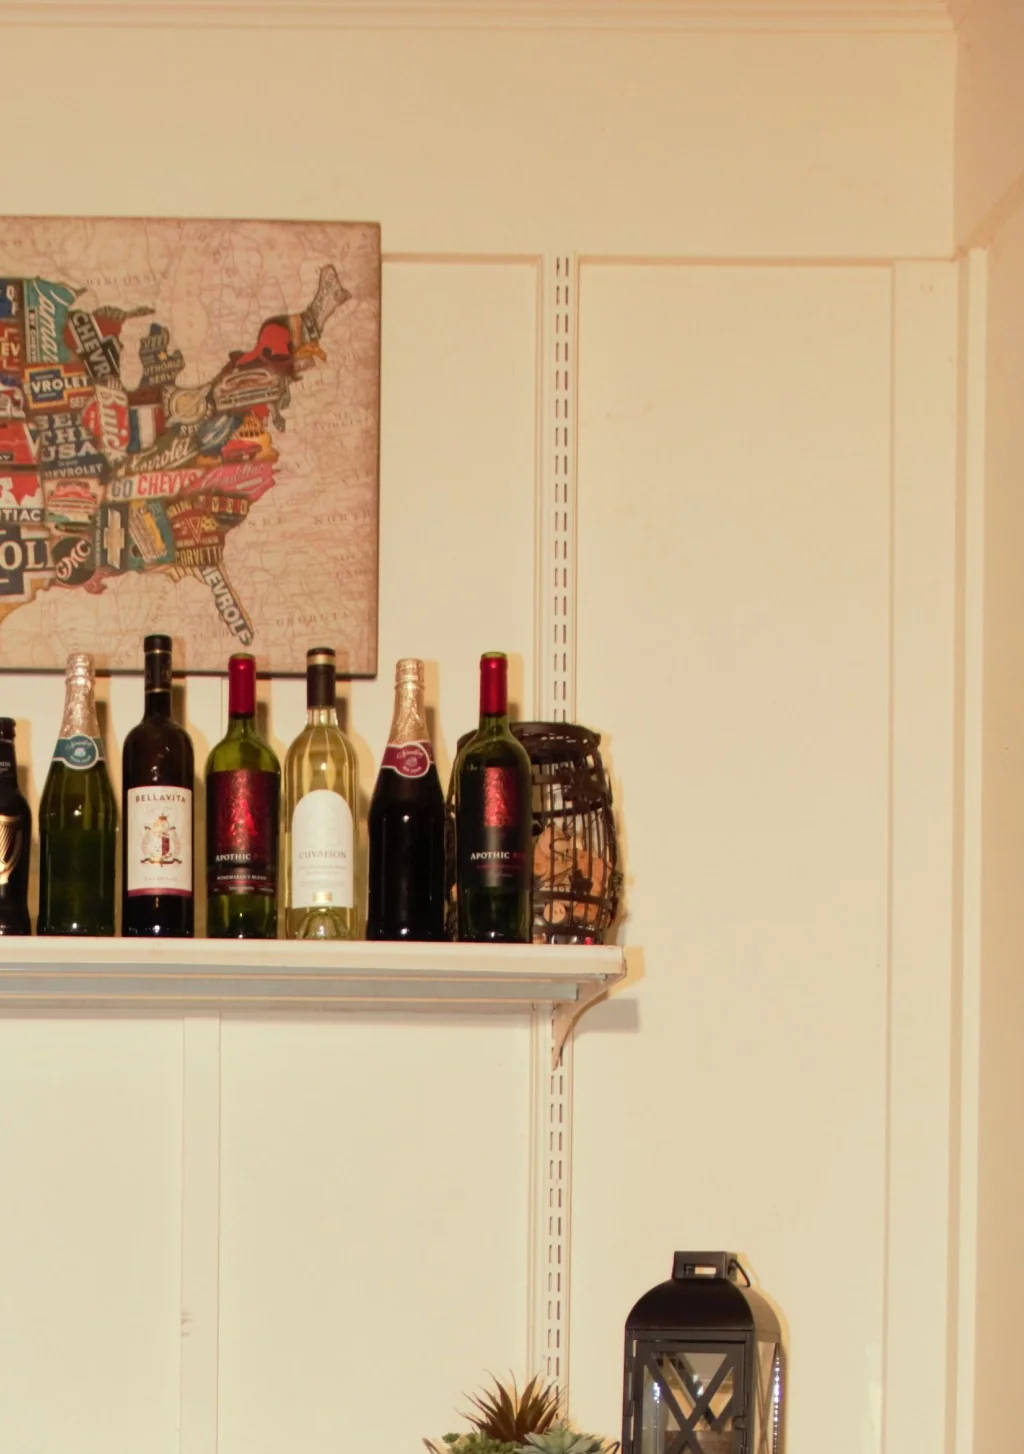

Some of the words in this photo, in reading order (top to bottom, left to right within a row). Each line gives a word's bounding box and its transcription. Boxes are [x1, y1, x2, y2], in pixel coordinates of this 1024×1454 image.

[135, 793, 187, 804] BELLAVITA
[215, 853, 252, 862] APOTHIC
[470, 851, 510, 860] APOTHIC
